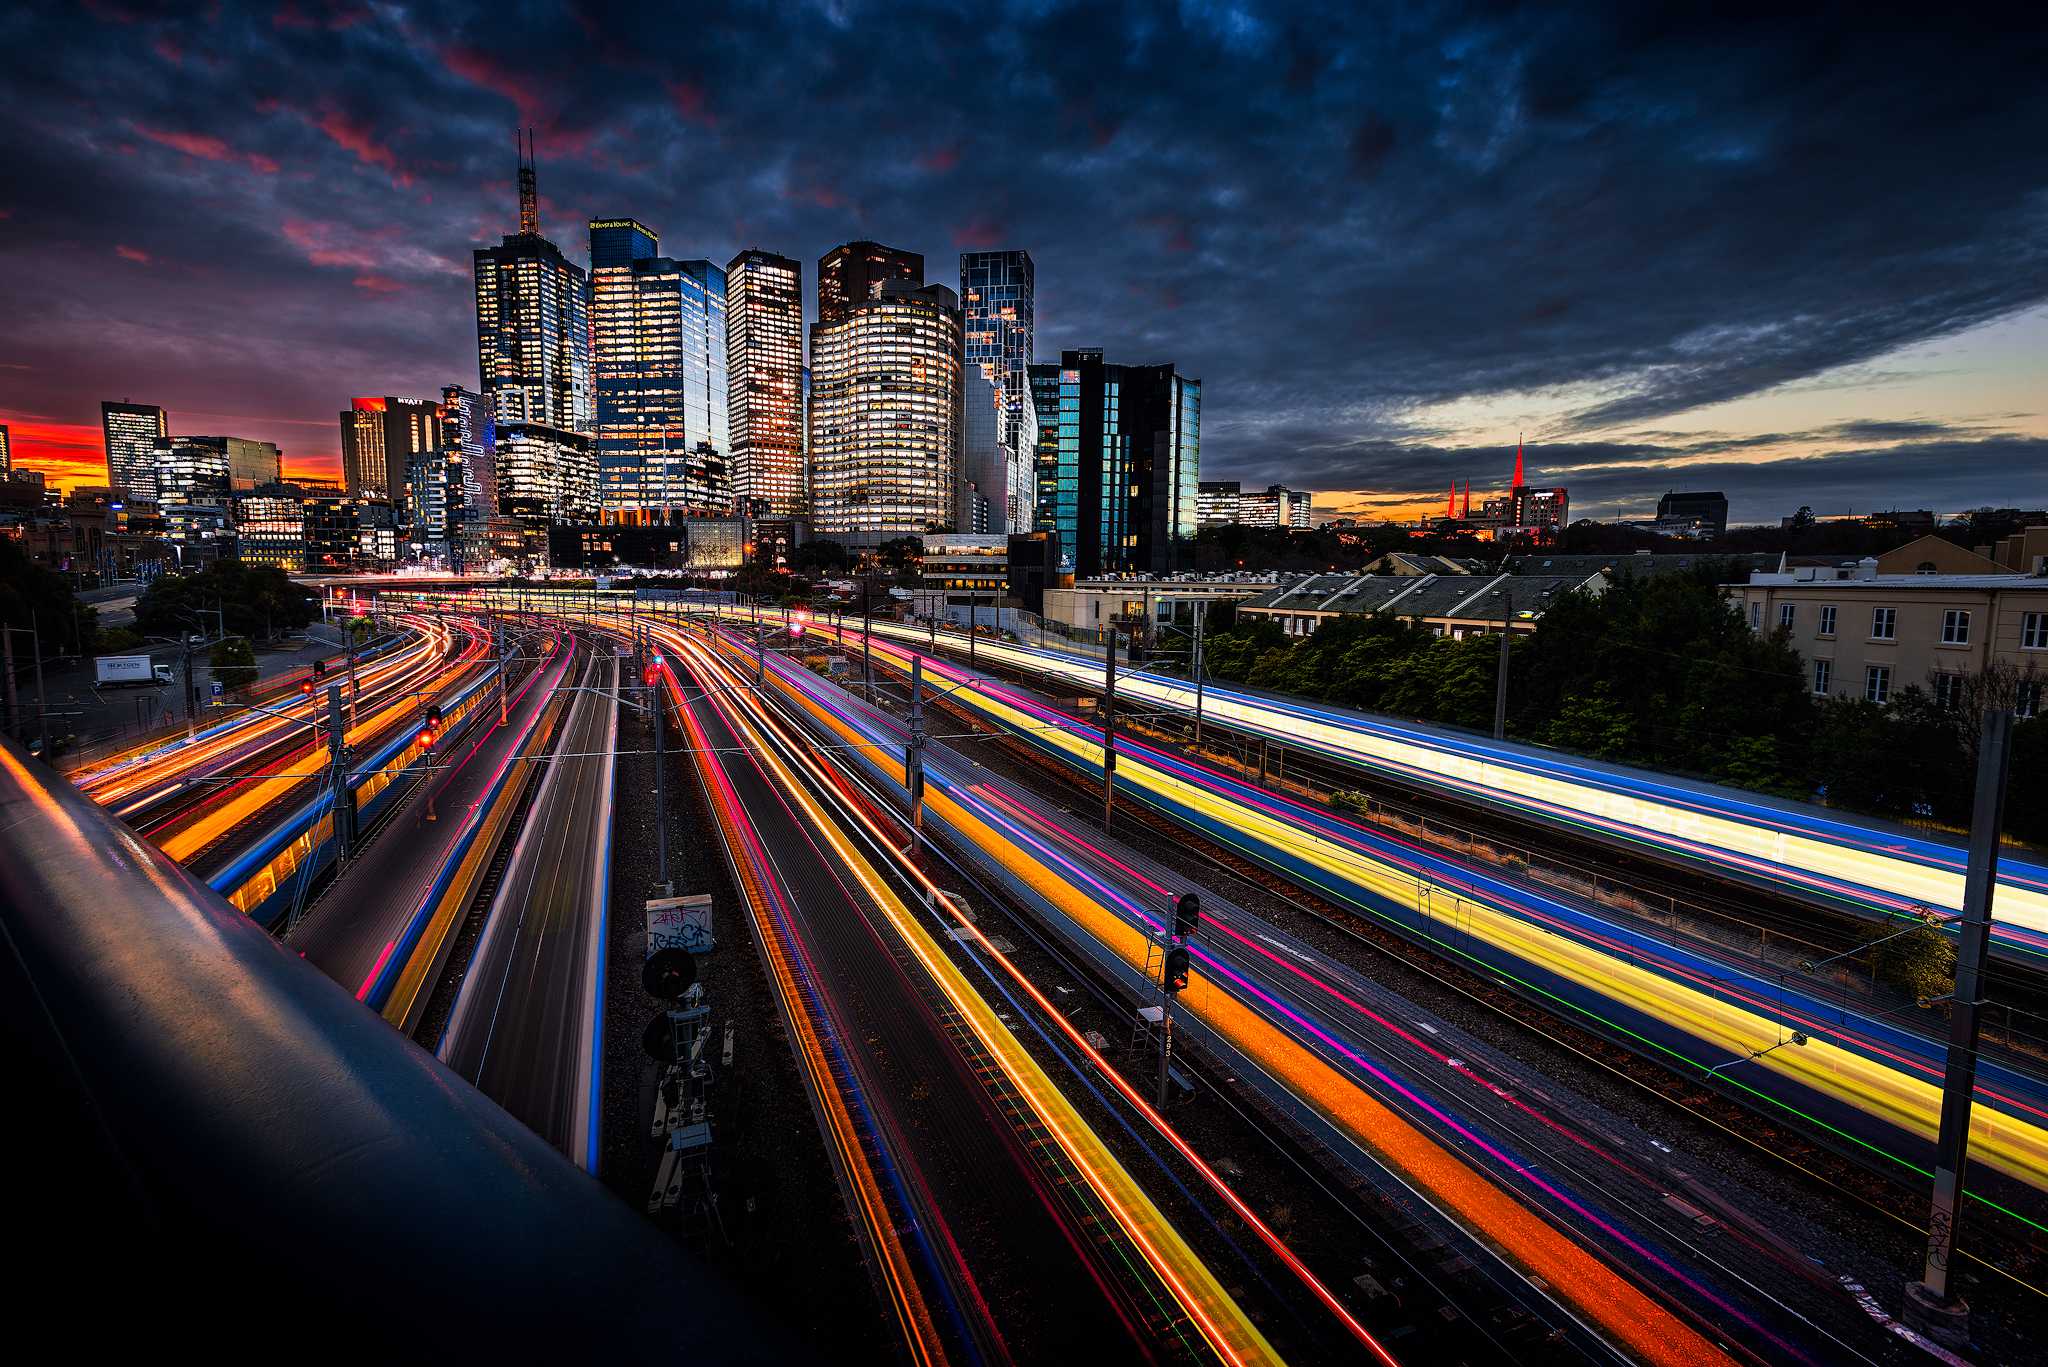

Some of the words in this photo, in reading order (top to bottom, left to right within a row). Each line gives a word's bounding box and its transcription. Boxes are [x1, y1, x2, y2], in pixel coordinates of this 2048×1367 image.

[397, 397, 424, 405] HYATT
[555, 519, 614, 527] HERALD
[642, 519, 671, 527] SUN
[213, 686, 221, 695] P
